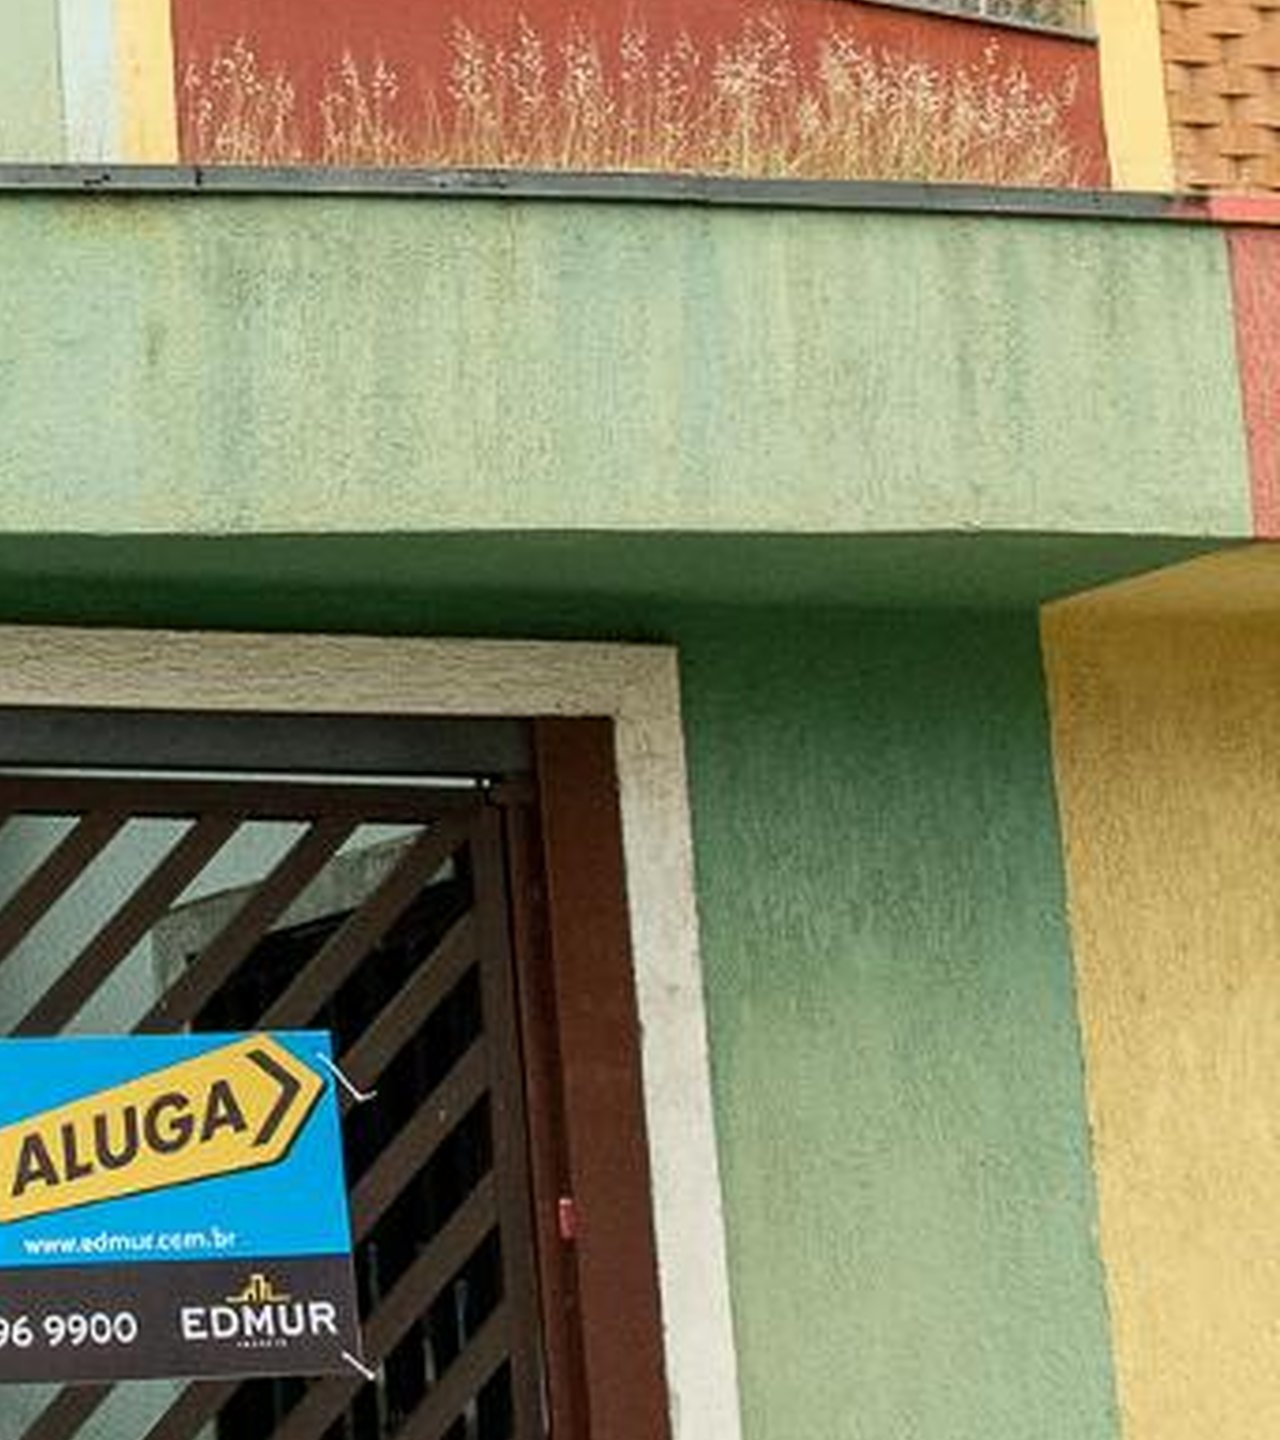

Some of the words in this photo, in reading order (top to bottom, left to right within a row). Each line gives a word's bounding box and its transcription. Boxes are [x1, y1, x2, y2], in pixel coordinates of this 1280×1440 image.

[10, 1079, 248, 1197] ALUGA
[23, 1226, 236, 1255] www.edmur.com.br
[44, 1311, 138, 1345] 9900
[180, 1301, 338, 1341] EDMUR
